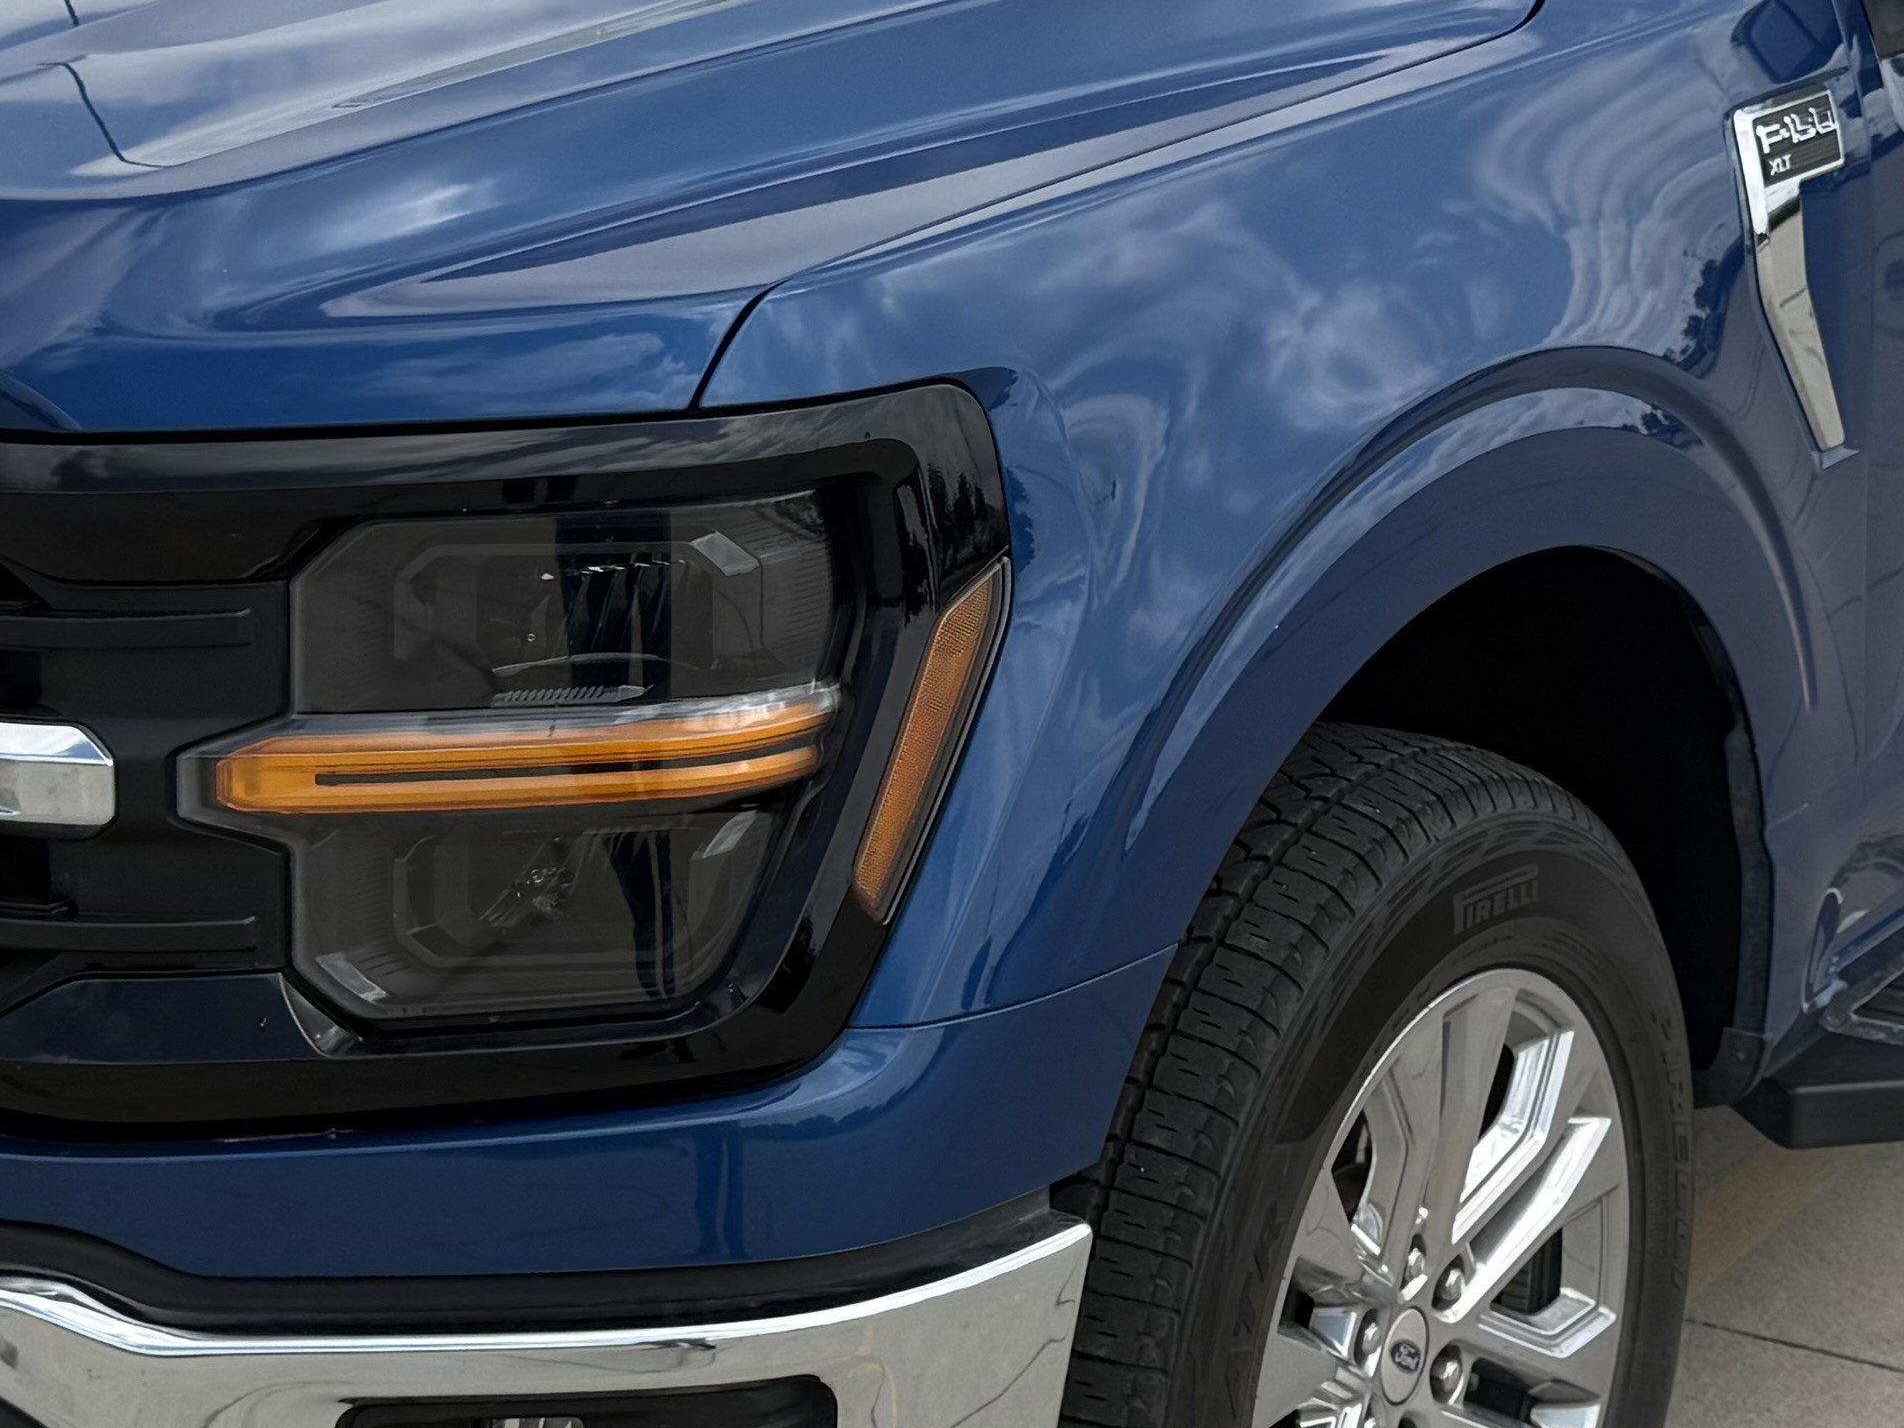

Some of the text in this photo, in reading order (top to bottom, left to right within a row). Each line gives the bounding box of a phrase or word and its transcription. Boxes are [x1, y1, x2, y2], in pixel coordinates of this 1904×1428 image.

[1756, 107, 1836, 154] F-150
[1768, 154, 1792, 176] XLT
[1452, 862, 1539, 935] PIRELLI
